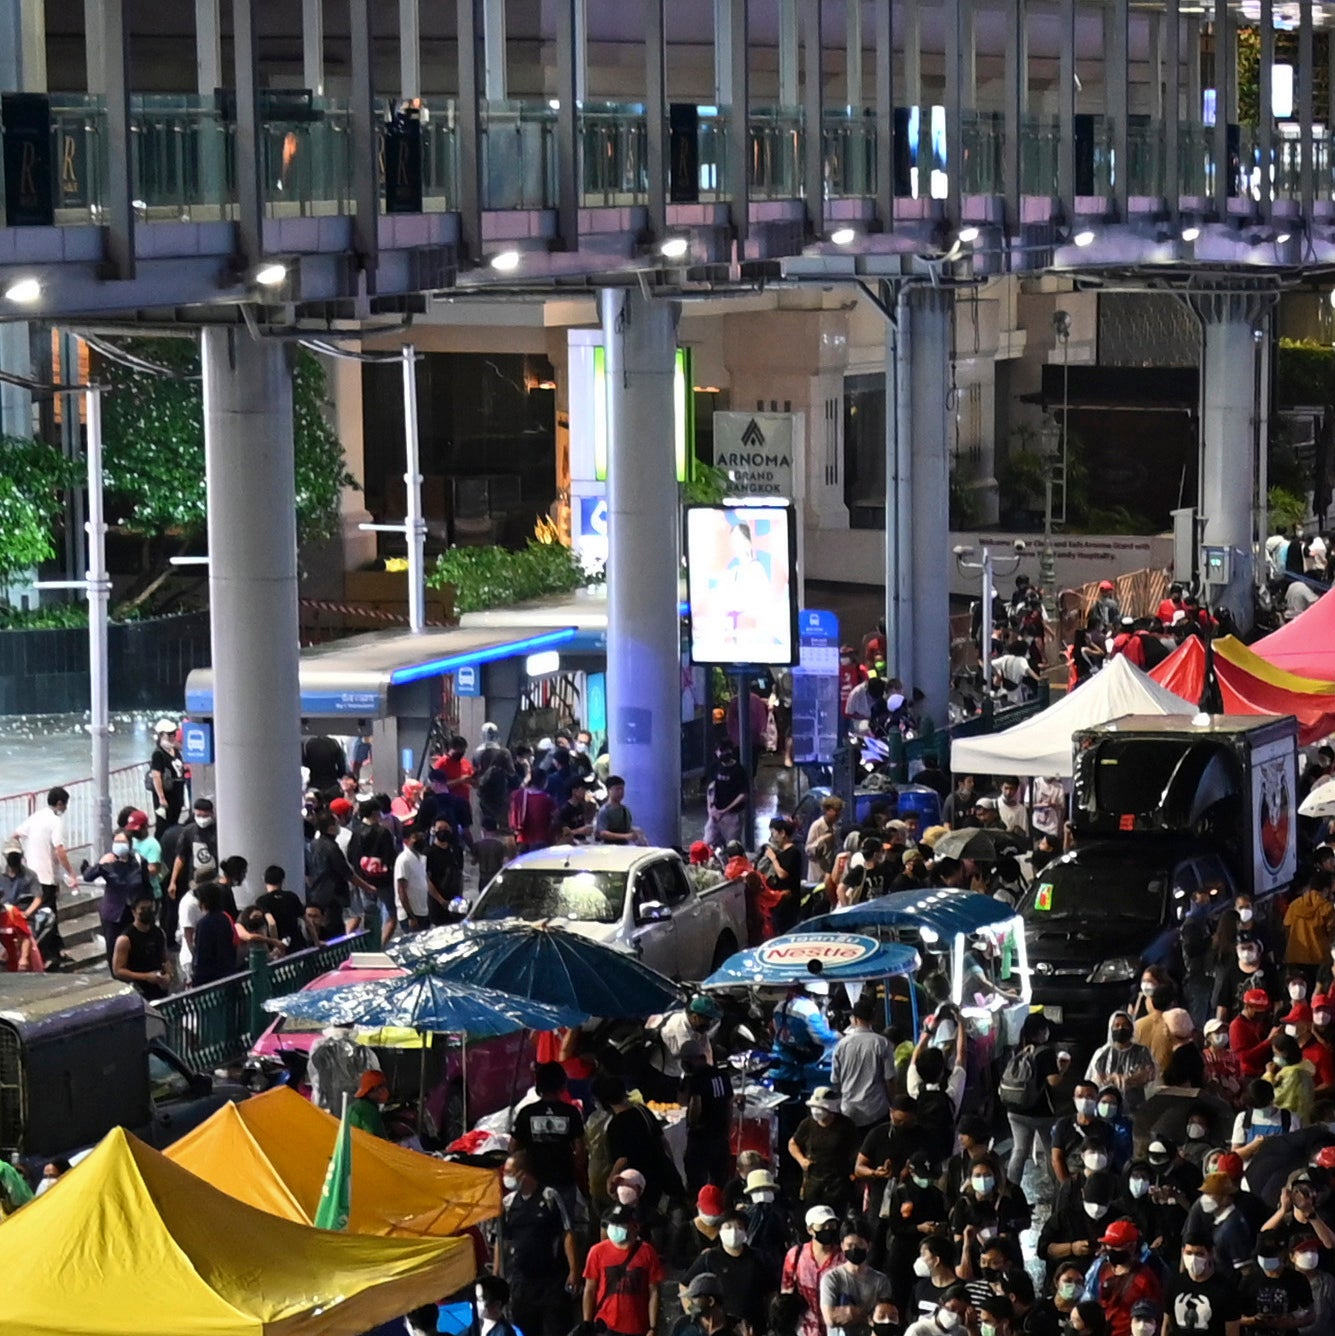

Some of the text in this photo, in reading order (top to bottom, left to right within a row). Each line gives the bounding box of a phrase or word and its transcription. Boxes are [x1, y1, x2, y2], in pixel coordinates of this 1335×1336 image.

[717, 453, 790, 467] ARNOMA
[734, 471, 773, 481] GRAND
[726, 484, 780, 494] BANGKOK
